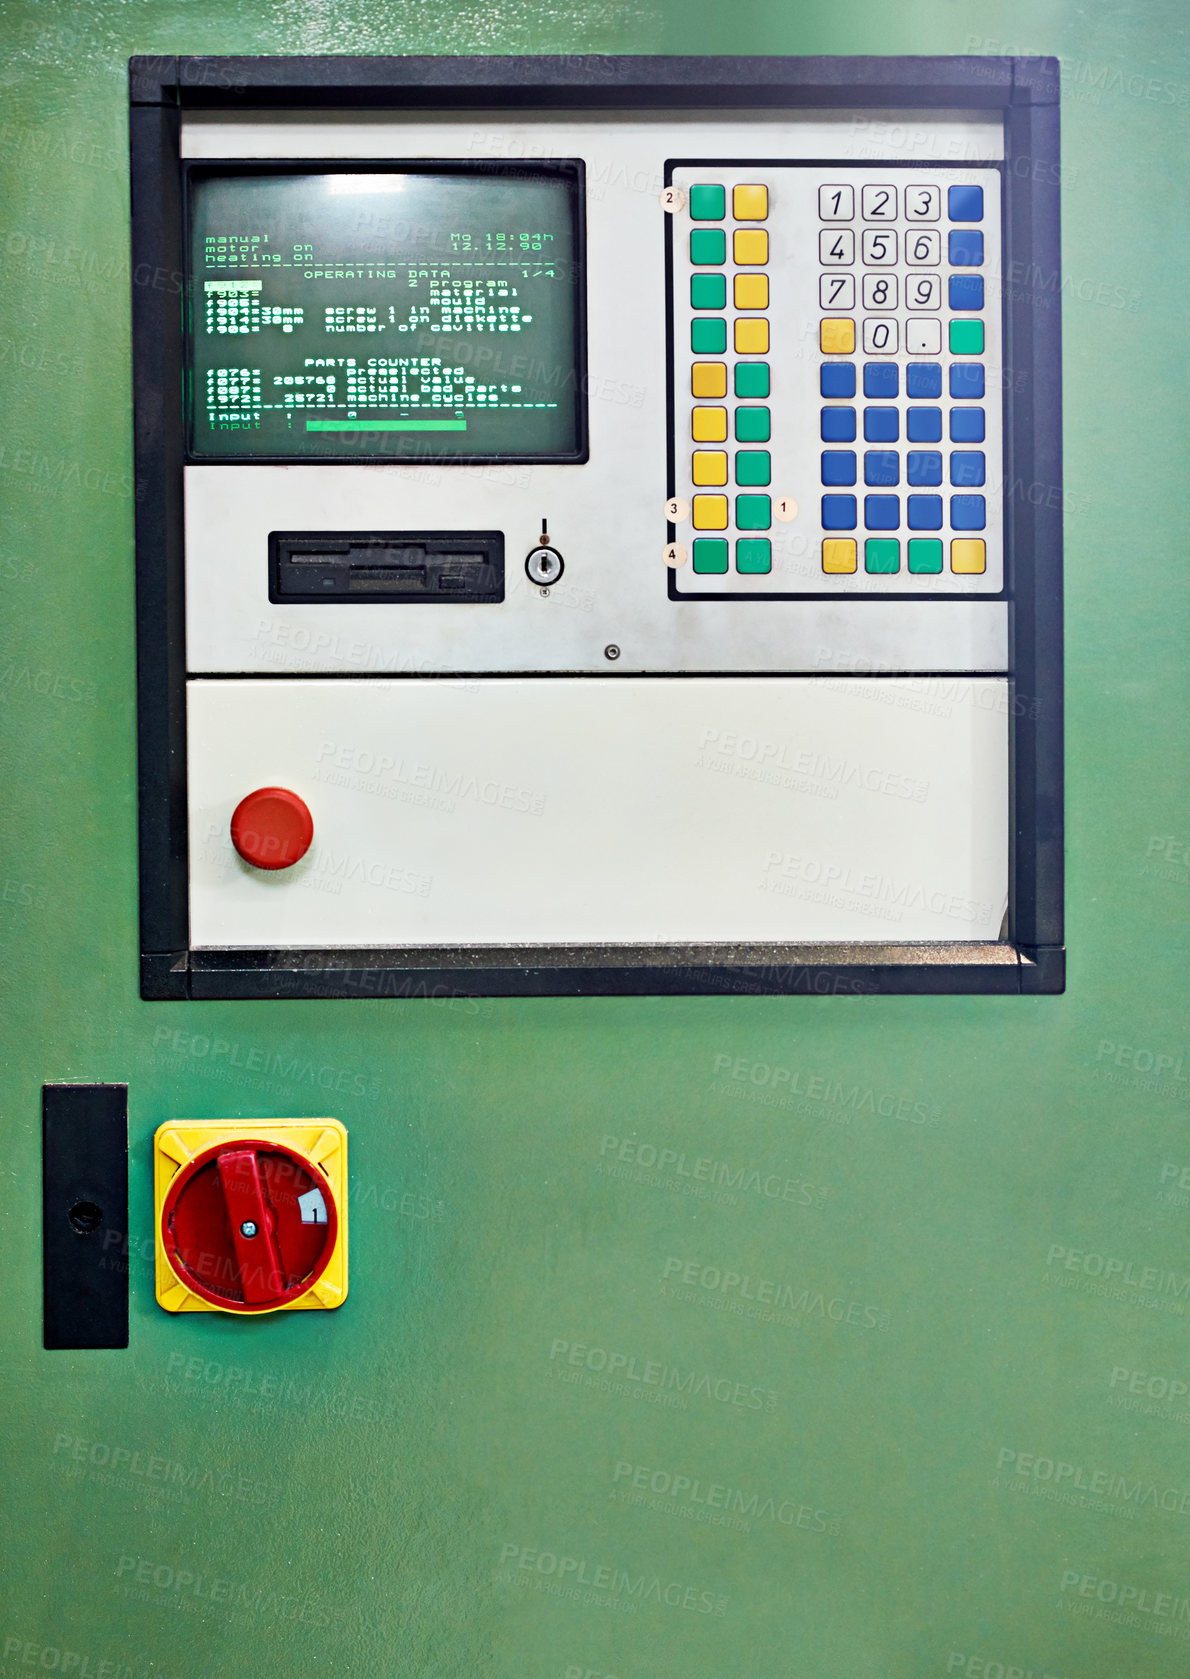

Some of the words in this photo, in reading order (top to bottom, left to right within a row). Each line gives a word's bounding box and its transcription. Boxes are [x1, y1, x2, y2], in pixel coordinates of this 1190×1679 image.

[666, 192, 673, 203] 2
[831, 191, 842, 215] 1
[870, 191, 890, 216] 2
[913, 191, 932, 216] 3
[206, 235, 268, 243] manual
[451, 233, 471, 241] Mo
[486, 233, 553, 241] 18:04h
[829, 235, 845, 260] 4
[870, 235, 890, 260] 5
[913, 235, 933, 260] 6
[206, 254, 281, 262] heating
[305, 271, 396, 279] OPERATING
[828, 279, 846, 304] 7
[872, 279, 889, 305] 8
[914, 280, 933, 305] 9
[206, 299, 259, 307] f905=
[430, 297, 485, 305] mould
[206, 307, 303, 316] f904=30mm
[325, 307, 376, 315] screw
[389, 306, 395, 314] 1
[411, 306, 429, 314] in
[441, 306, 520, 314] machine
[207, 316, 303, 325] f914=30mm
[389, 315, 395, 323] 1
[409, 315, 429, 323] on
[442, 315, 532, 323] diskette
[207, 325, 259, 334] f906=
[326, 324, 385, 332] number
[399, 324, 416, 332] of
[431, 324, 521, 332] cavities
[872, 324, 890, 349] 0
[305, 358, 356, 367] PARTS
[207, 369, 260, 377] f076=
[347, 368, 464, 376] preselected
[207, 377, 261, 386] f077=
[347, 376, 407, 384] actual
[421, 376, 475, 384] value
[207, 386, 261, 394] f087=
[326, 385, 336, 393] 0
[347, 386, 406, 394] actual
[421, 385, 453, 393] bad
[465, 385, 521, 394] parts
[207, 395, 261, 403] f972=
[285, 394, 333, 402] 25721
[347, 394, 420, 402] machine
[432, 394, 498, 402] cycles
[209, 413, 260, 421] Input
[348, 411, 357, 419] 0
[211, 422, 260, 431] Input
[670, 503, 678, 514] 3
[781, 502, 786, 512] 1
[668, 549, 676, 560] 4
[312, 1208, 317, 1224] 1
